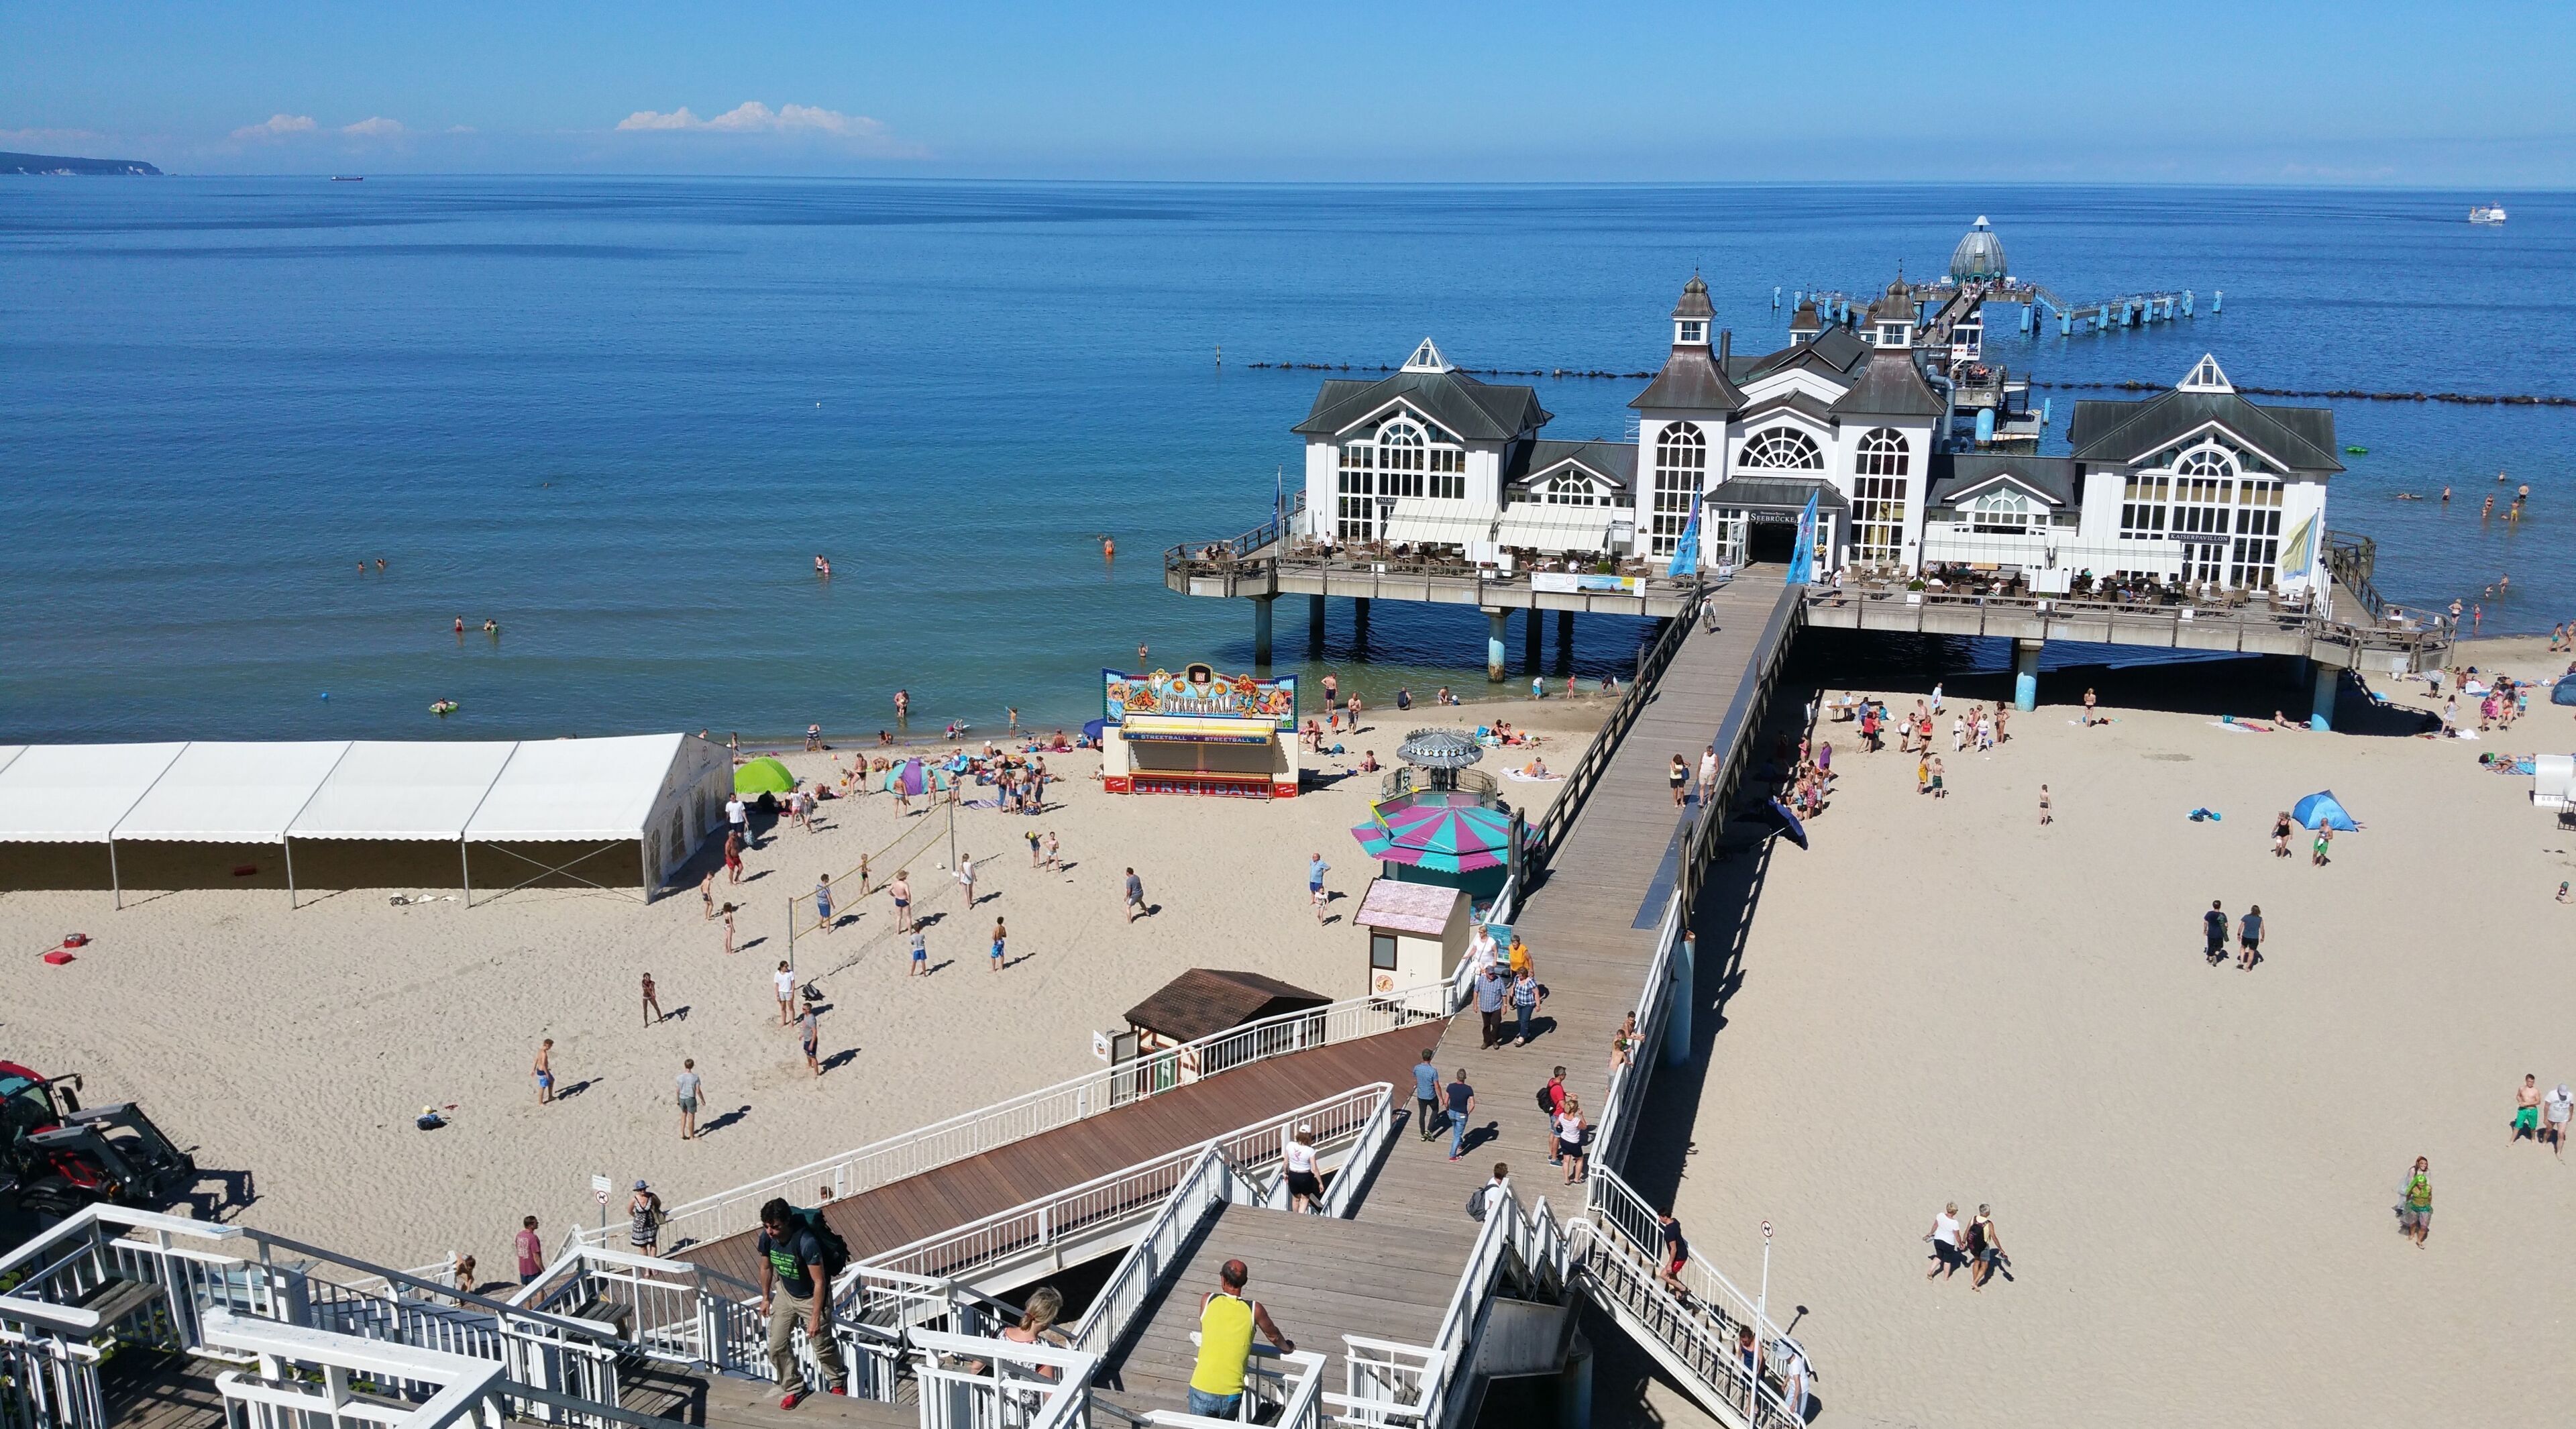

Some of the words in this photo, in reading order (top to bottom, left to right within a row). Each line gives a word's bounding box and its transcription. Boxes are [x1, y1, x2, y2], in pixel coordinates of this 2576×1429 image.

[1750, 513, 1794, 522] SEEBRÜCKE
[1164, 692, 1235, 714] STREETBALL
[1135, 780, 1269, 796] STREETBALL
